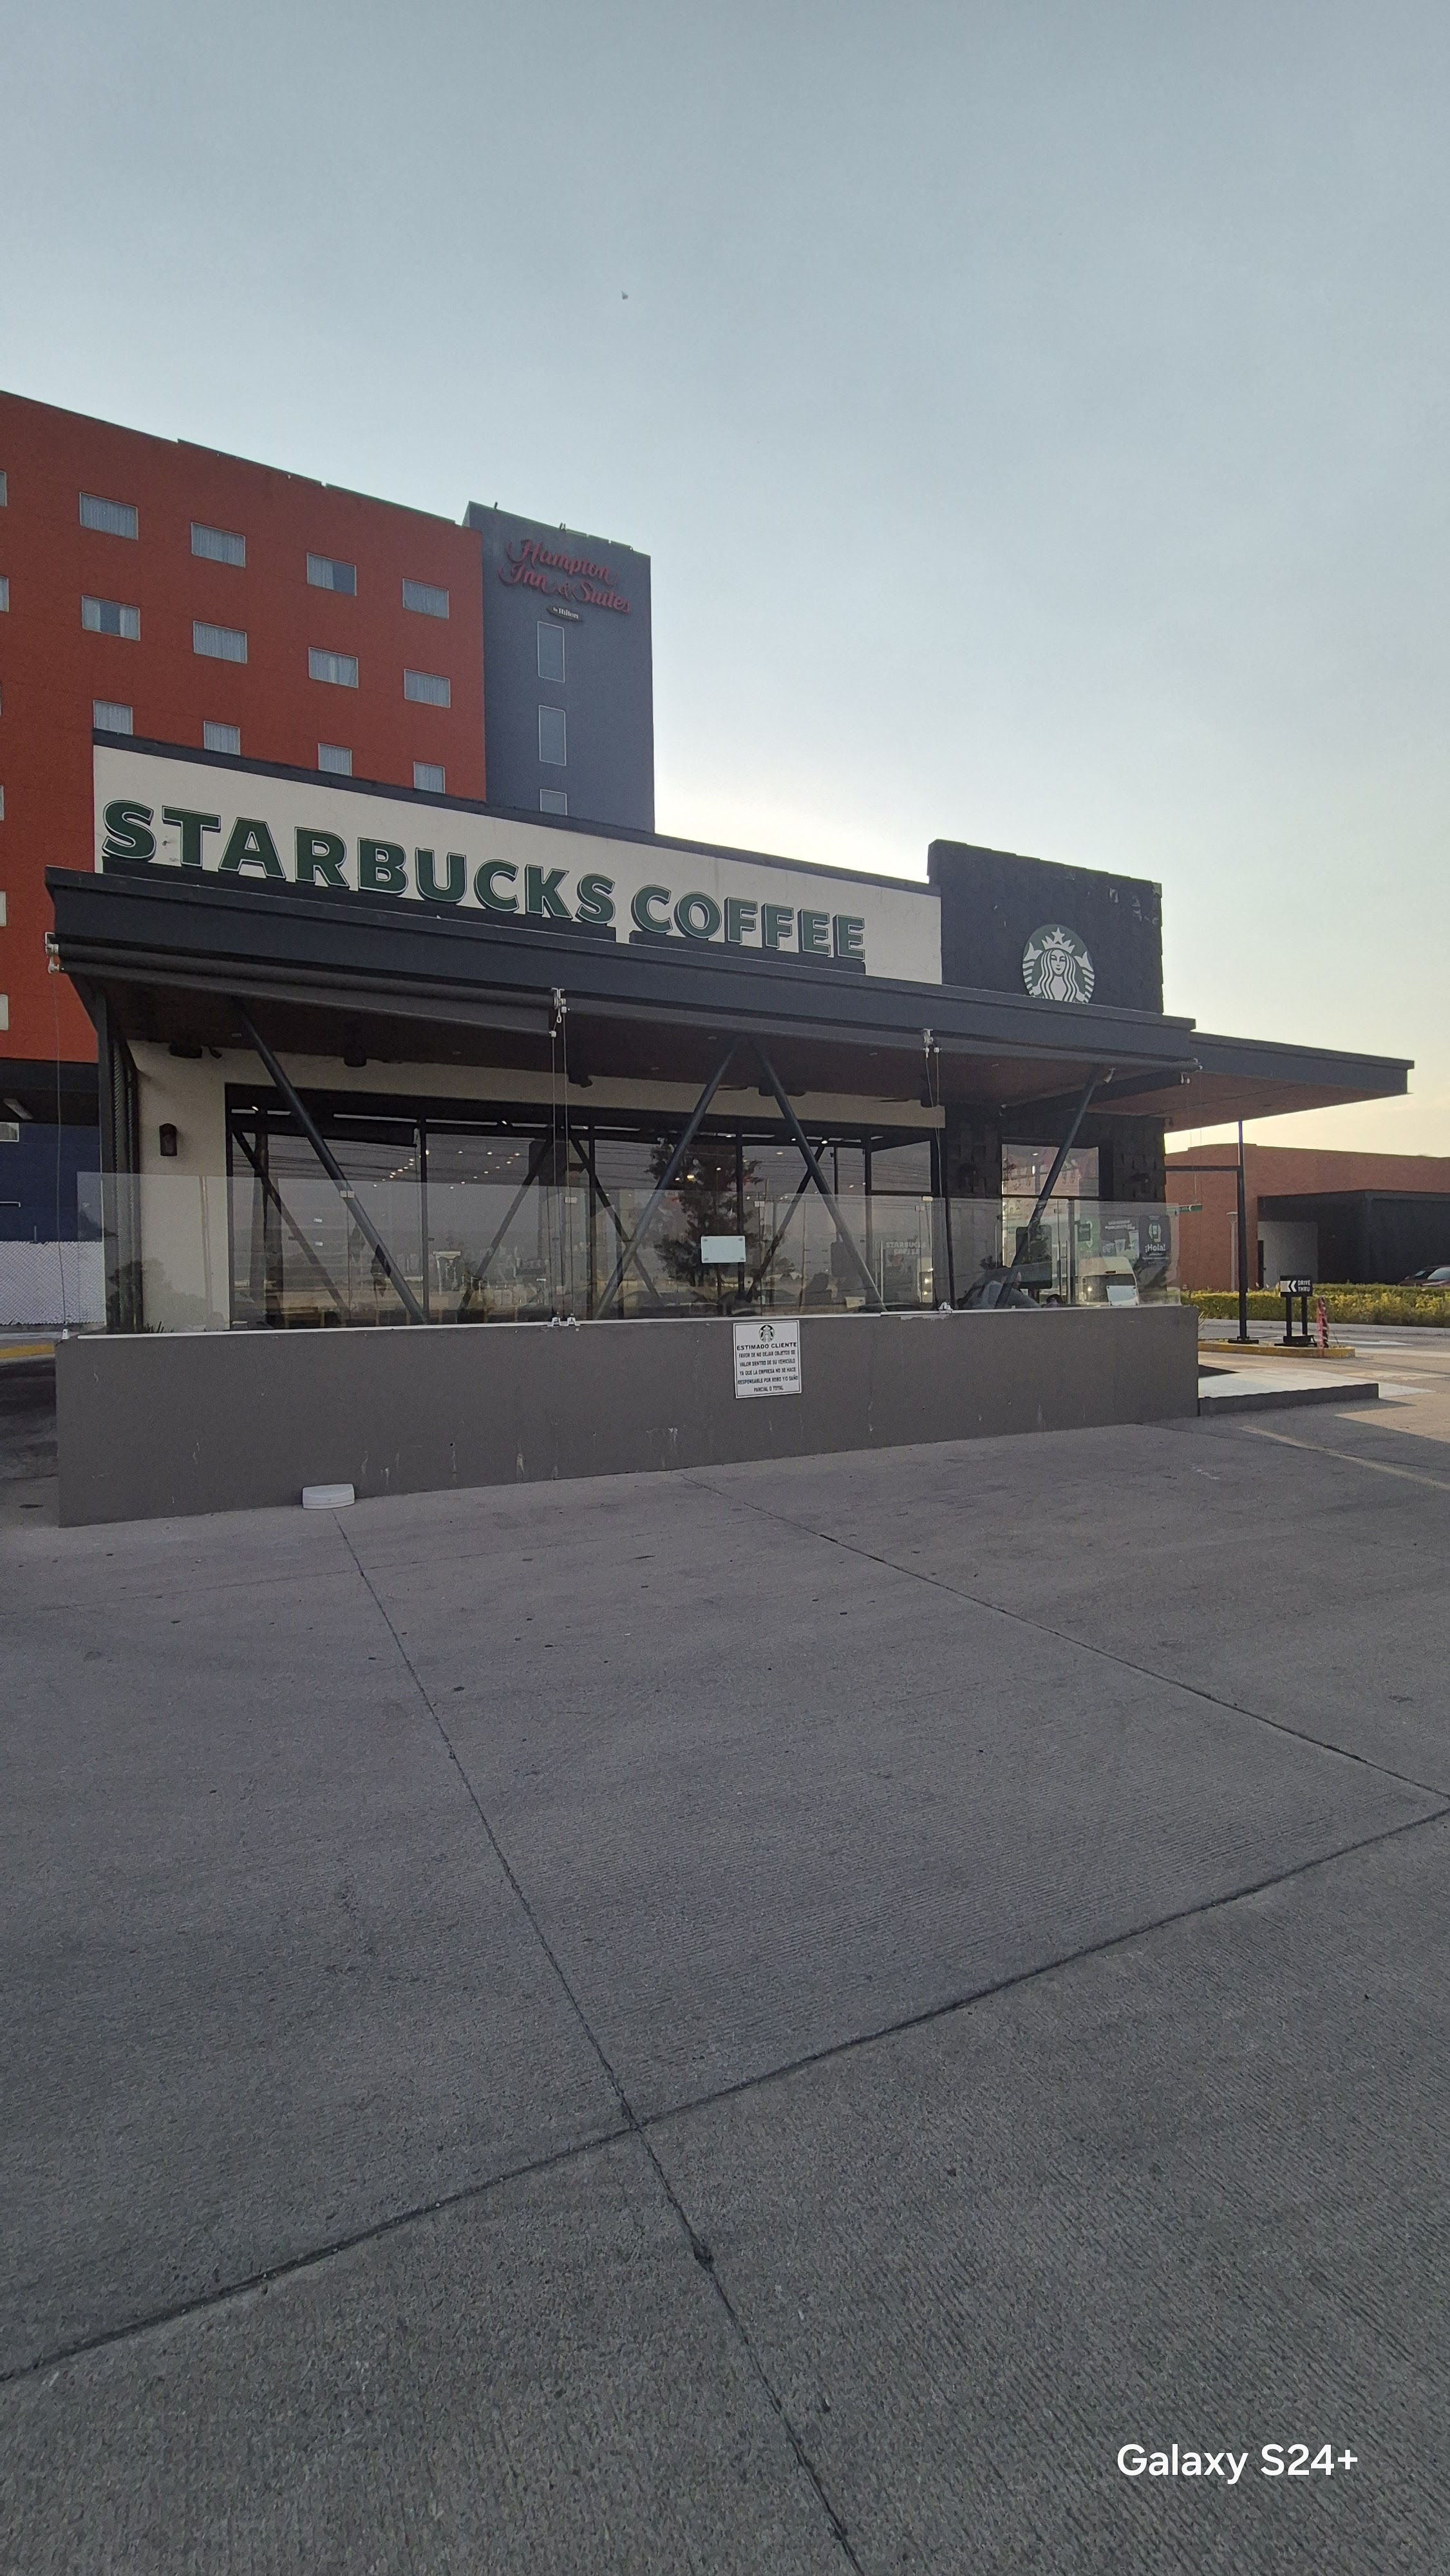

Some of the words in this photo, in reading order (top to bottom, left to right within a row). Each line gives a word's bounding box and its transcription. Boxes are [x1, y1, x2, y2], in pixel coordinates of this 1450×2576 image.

[505, 539, 618, 586] Hampton
[498, 564, 557, 595] Inn
[572, 580, 630, 614] Suites
[558, 608, 579, 619] Hilton
[102, 800, 616, 925] STARBUCKS
[630, 884, 865, 960] COFFEE
[1145, 1244, 1166, 1253] ¡Hola!
